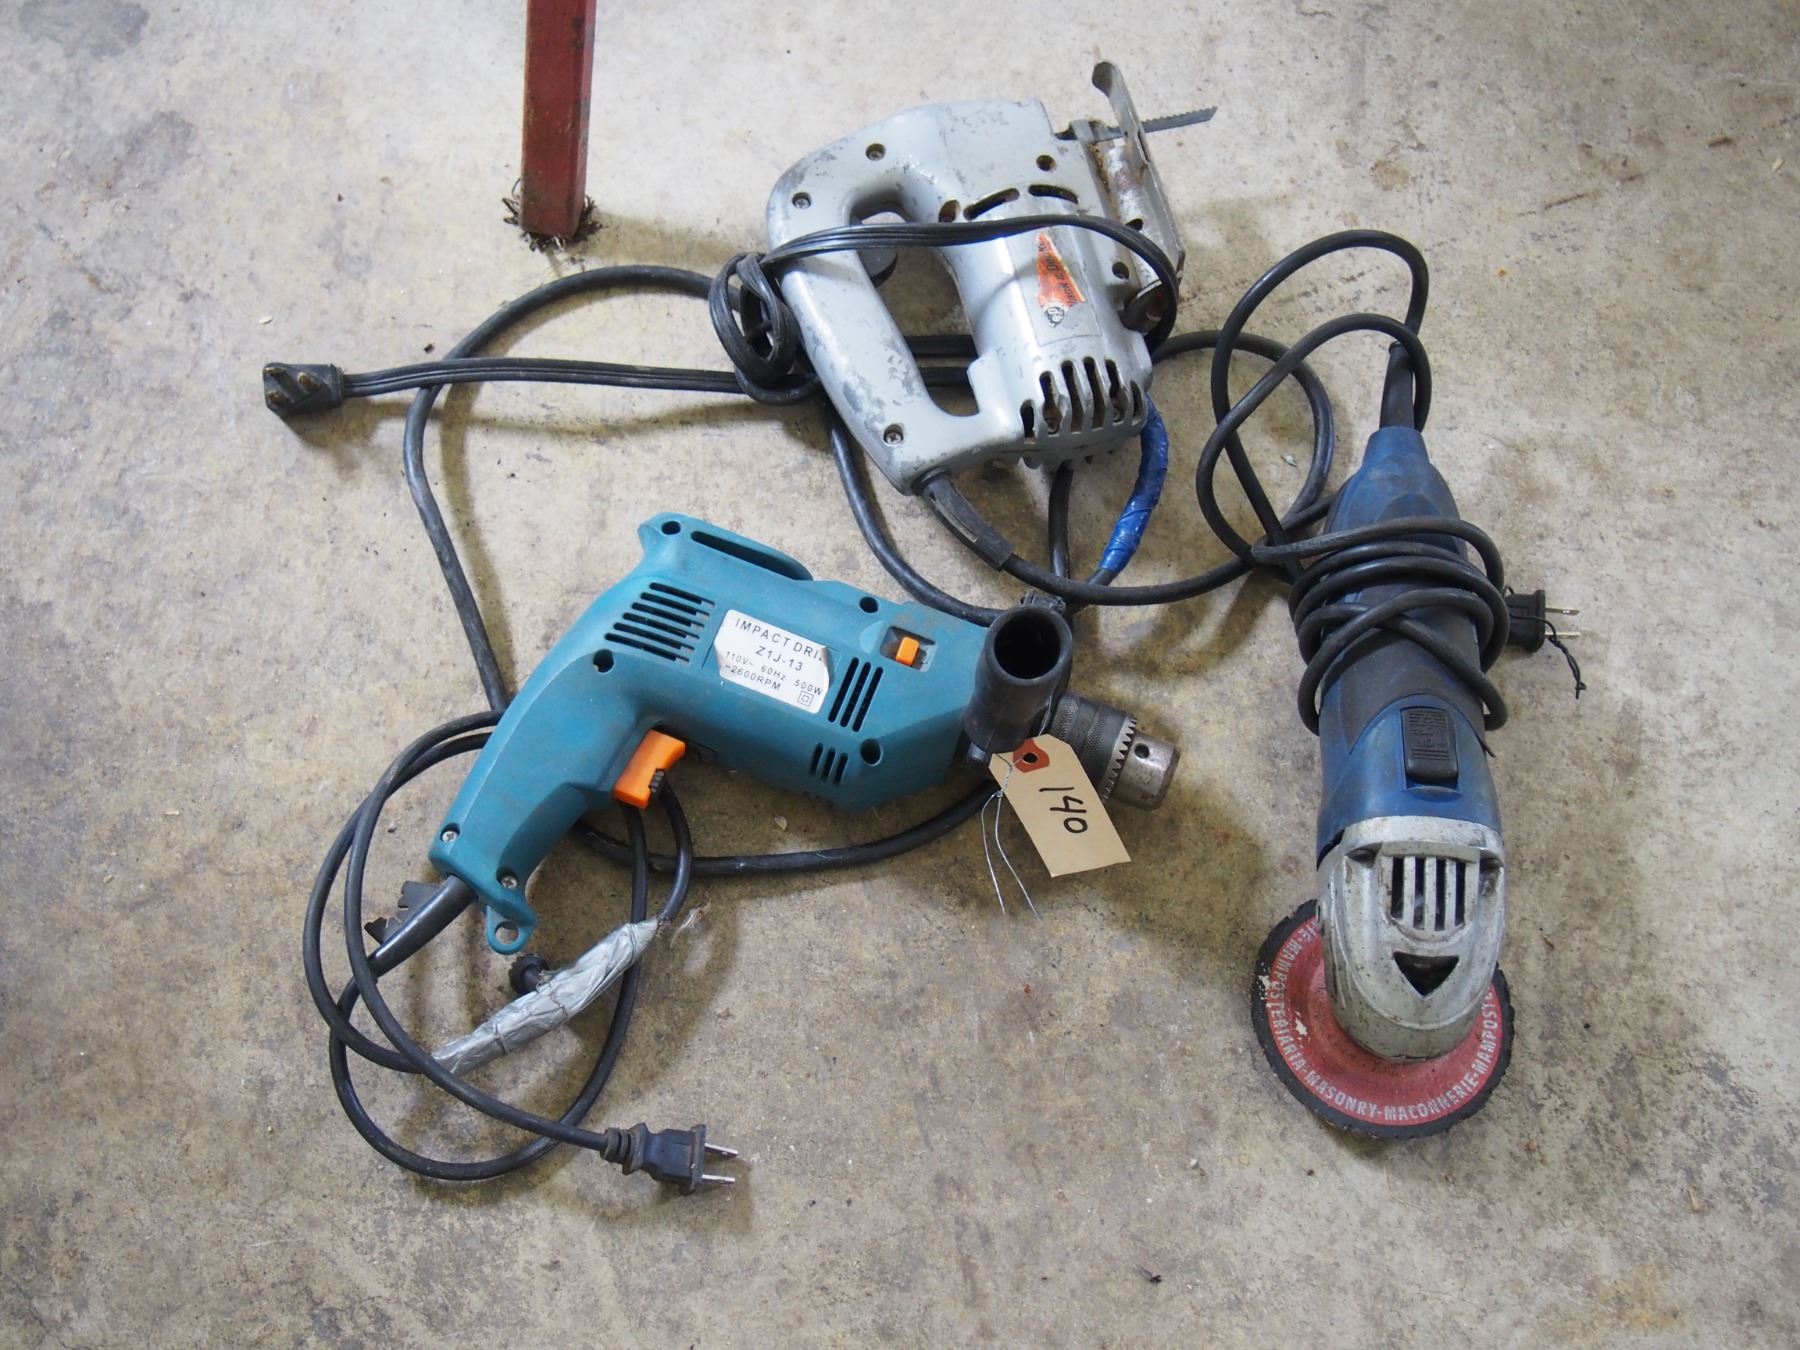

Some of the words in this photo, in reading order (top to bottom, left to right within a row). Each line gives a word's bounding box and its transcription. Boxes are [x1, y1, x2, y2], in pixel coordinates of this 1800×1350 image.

[735, 617, 792, 647] IMPACT
[755, 645, 804, 672] Z1J-13
[760, 665, 787, 682] 60Hz
[794, 679, 823, 696] 500W
[1038, 786, 1089, 834] 140
[1305, 1070, 1377, 1120] MASONRY
[1384, 1072, 1480, 1121] MACONNERIE
